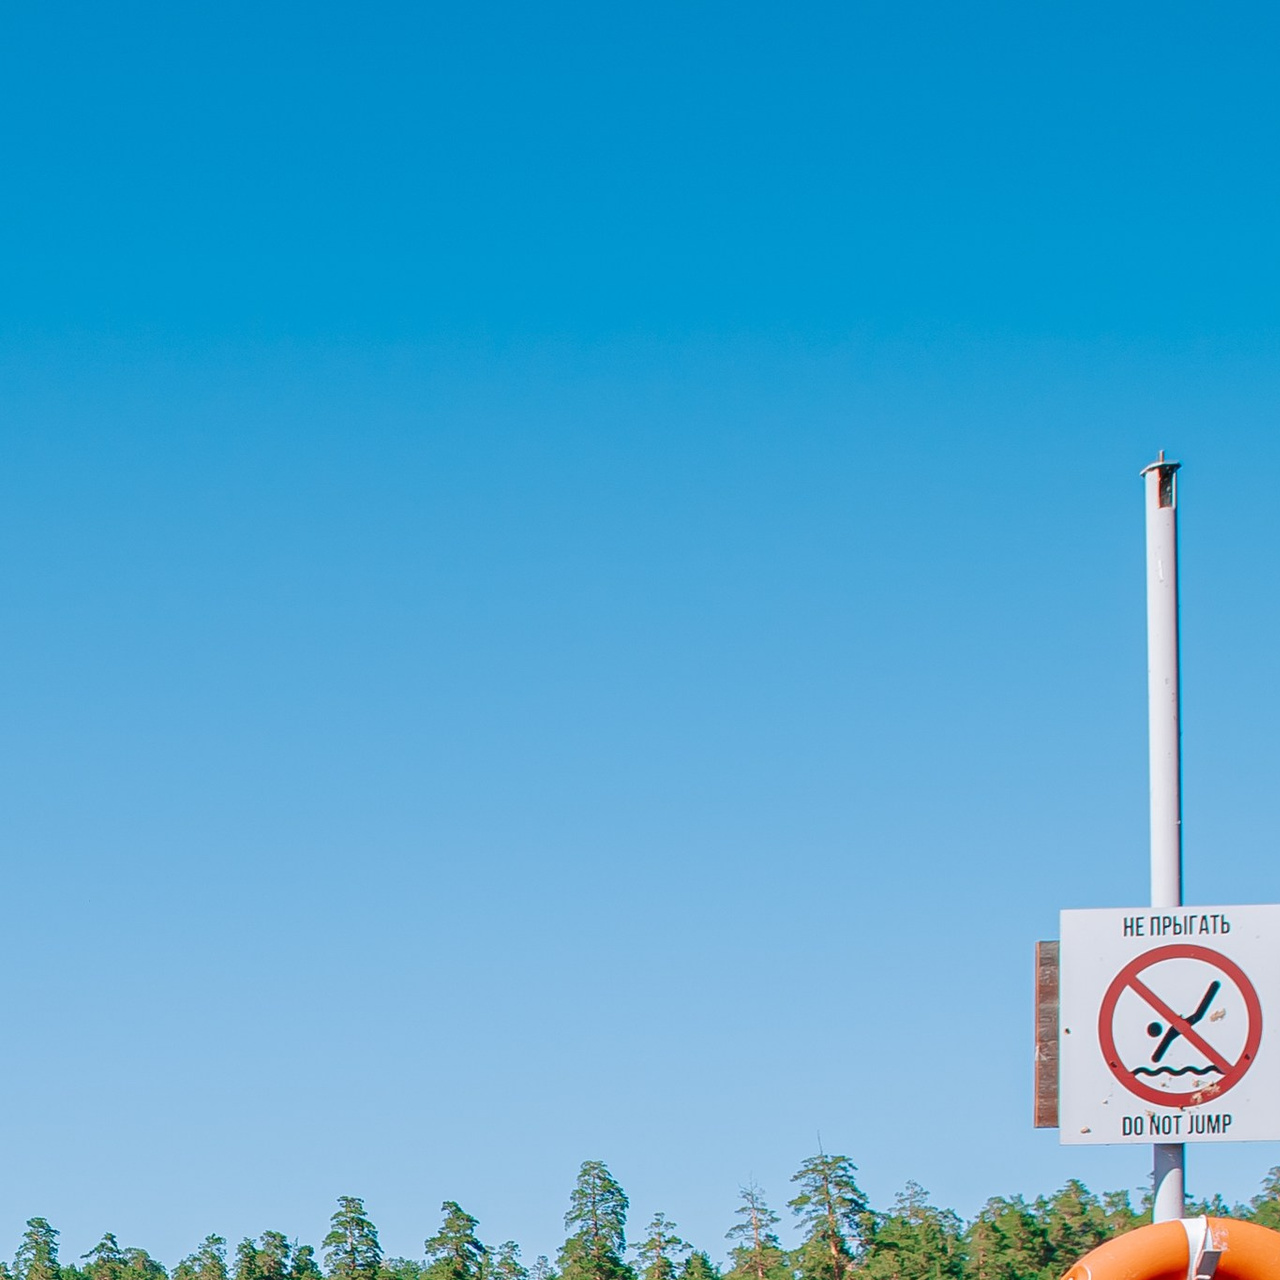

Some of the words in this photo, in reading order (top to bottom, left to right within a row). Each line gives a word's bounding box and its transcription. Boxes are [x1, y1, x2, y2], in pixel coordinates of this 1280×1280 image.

[1123, 917, 1144, 936] НЕ
[1150, 914, 1231, 936] ПРЫГАТЬ
[1122, 1116, 1143, 1136] DO
[1149, 1115, 1182, 1136] NOT
[1187, 1114, 1232, 1135] JUMP
